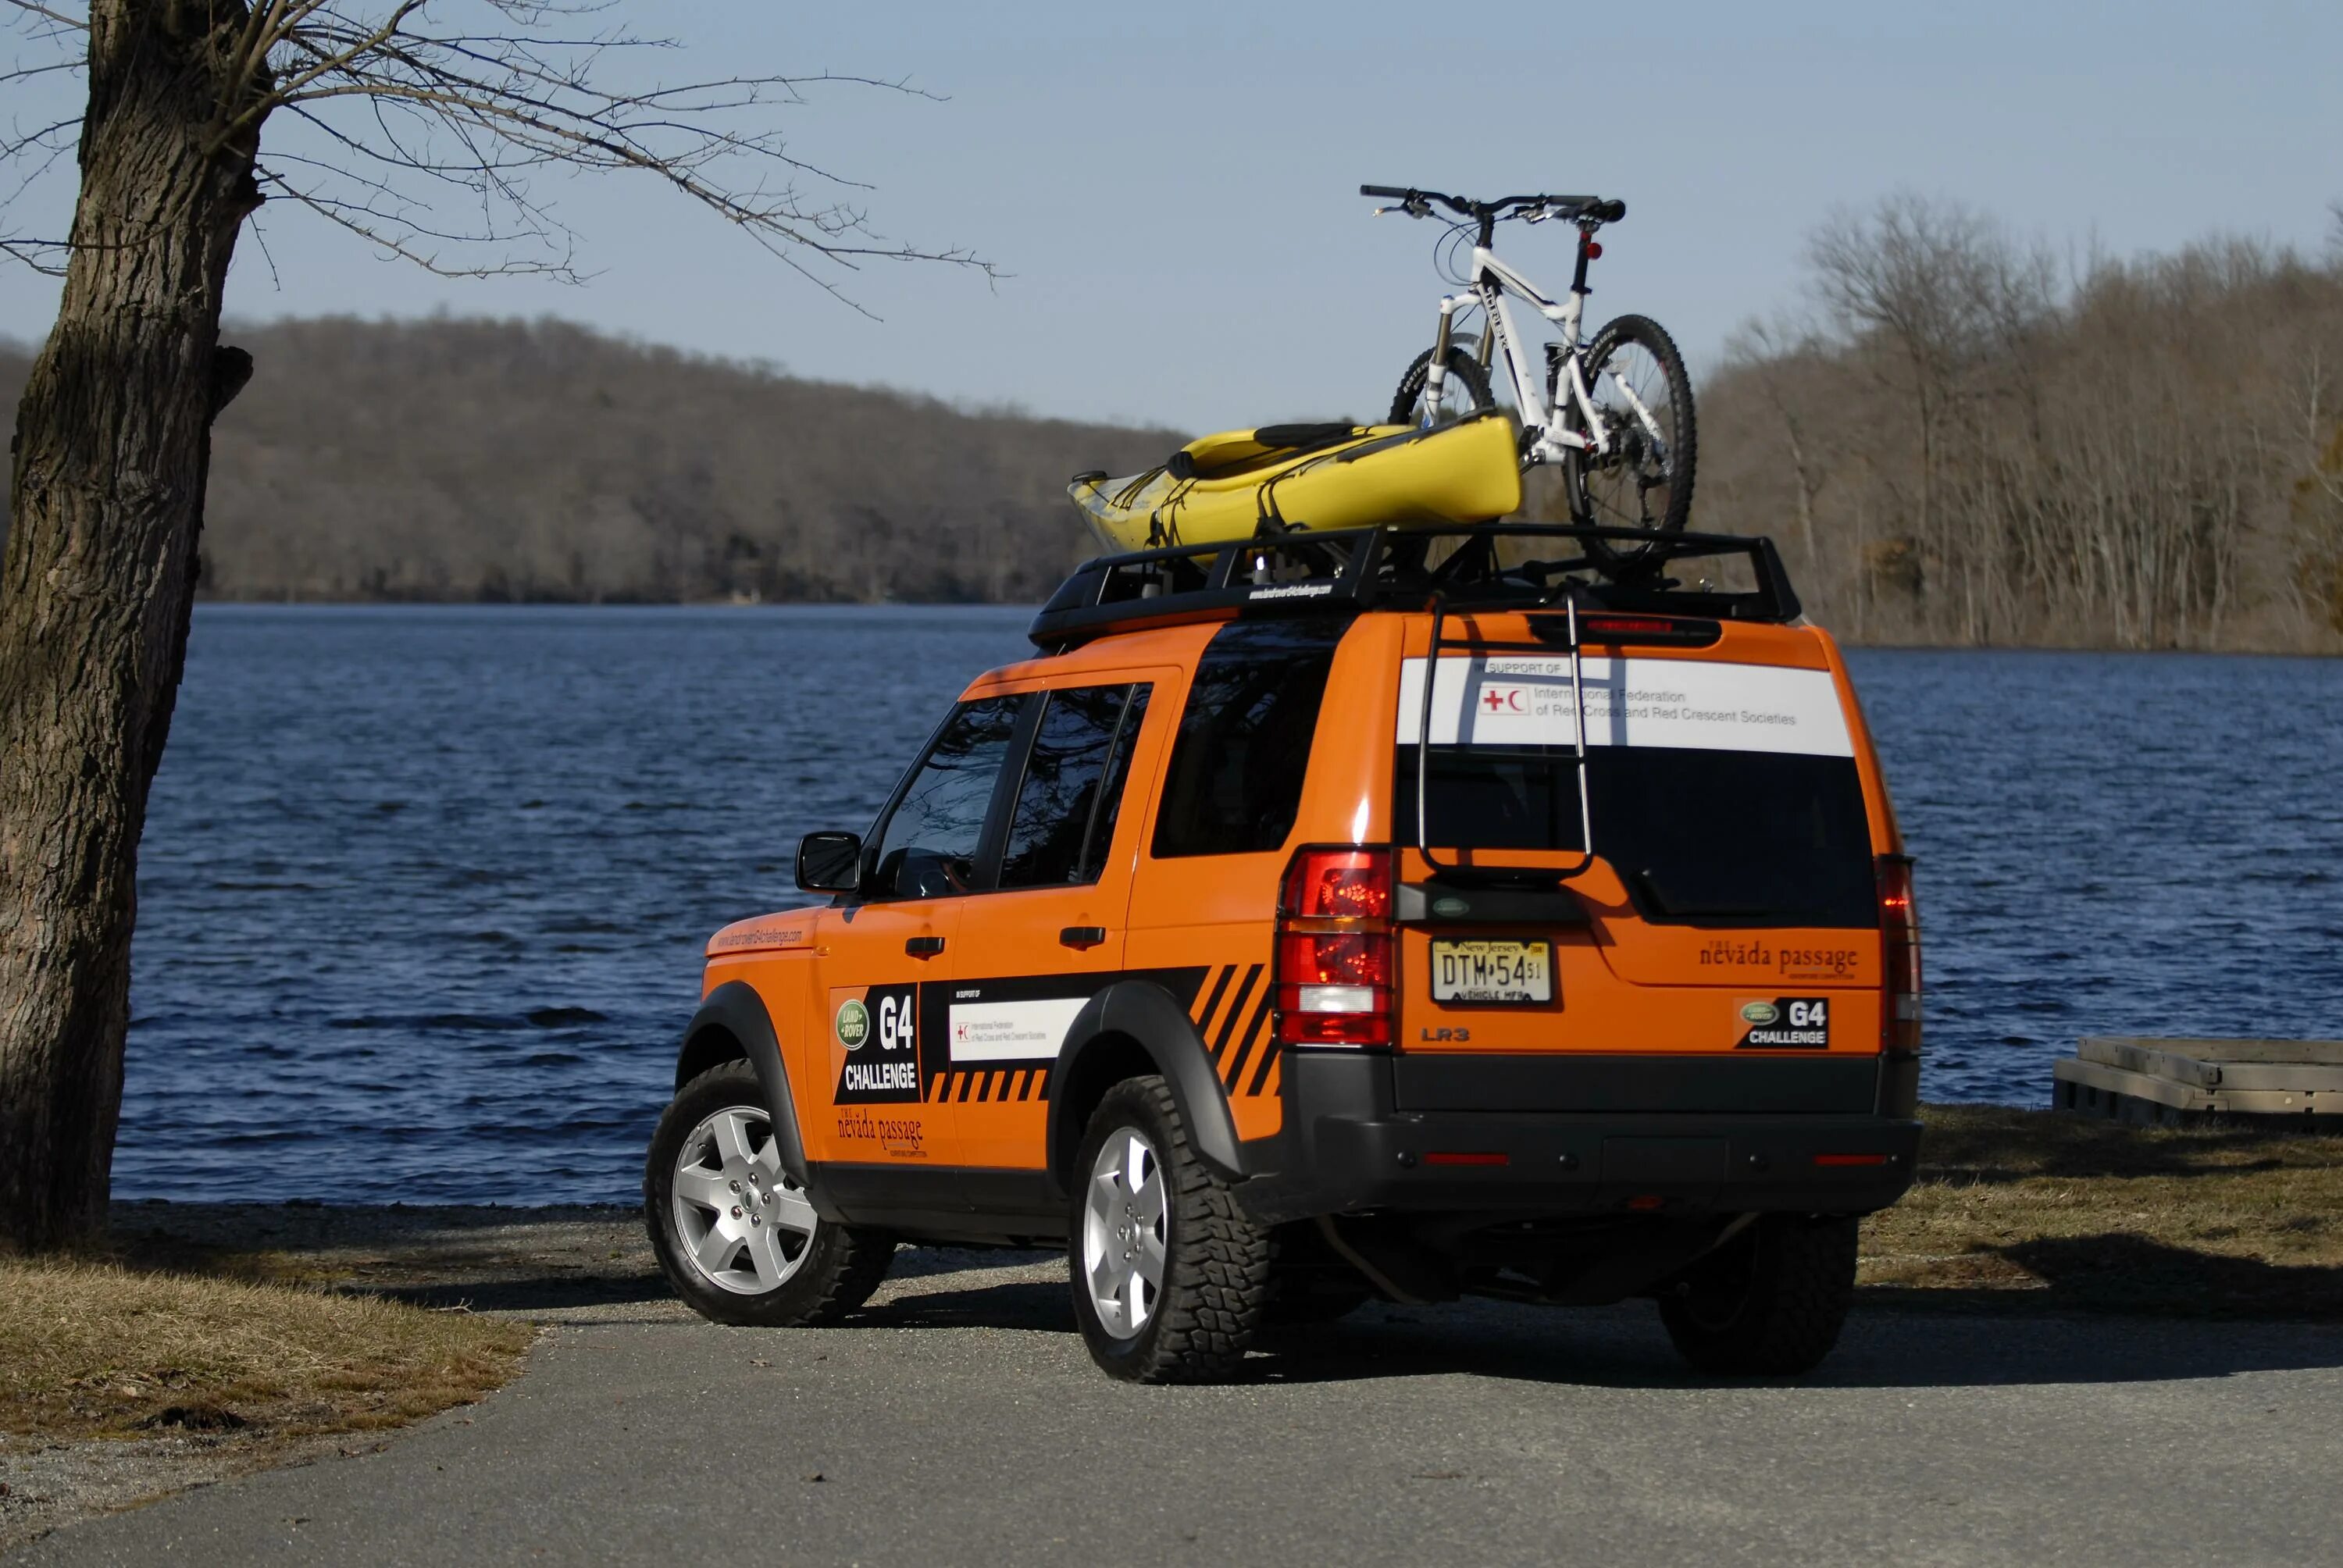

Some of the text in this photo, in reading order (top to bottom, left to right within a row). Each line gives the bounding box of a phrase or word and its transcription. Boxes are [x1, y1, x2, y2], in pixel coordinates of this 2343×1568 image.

[1584, 328, 1617, 368] ONTRAGER
[1489, 663, 1543, 674] SUPPORT
[1547, 664, 1561, 674] OF
[1534, 688, 1686, 703] Internional Federation
[1535, 705, 1796, 726] of Re Cross and Red Crescent Societies
[1460, 942, 1520, 953] New Jersey
[1779, 949, 1859, 975] passage
[843, 1010, 859, 1023] LAND
[879, 995, 913, 1050] G4
[1789, 1001, 1827, 1027] G4
[844, 1024, 864, 1037] ROVER
[1421, 1028, 1470, 1042] LR3
[1749, 1031, 1827, 1044] CHALLENGE
[845, 1062, 916, 1090] CHALLENGE
[879, 1118, 923, 1150] passage
